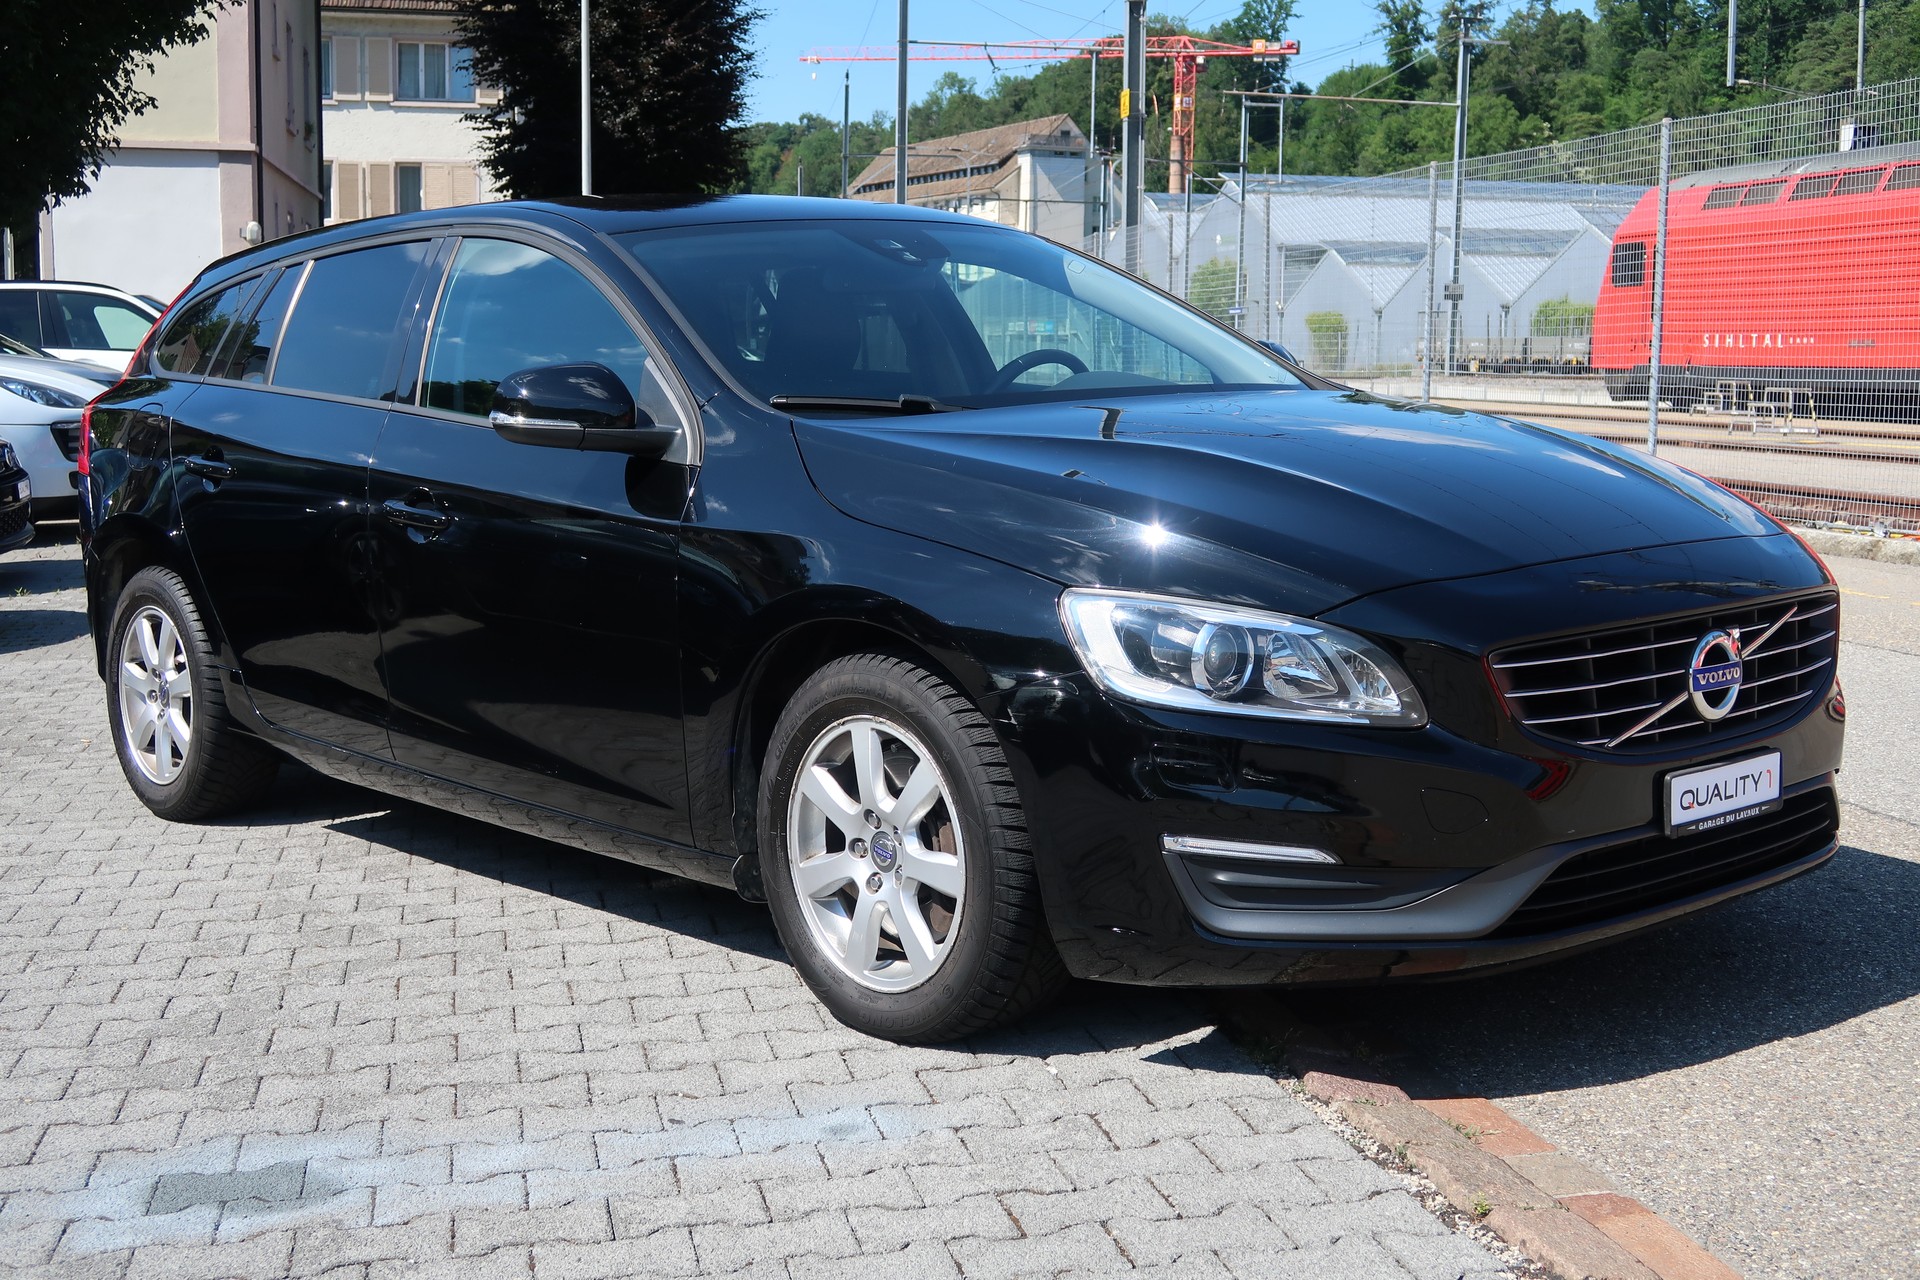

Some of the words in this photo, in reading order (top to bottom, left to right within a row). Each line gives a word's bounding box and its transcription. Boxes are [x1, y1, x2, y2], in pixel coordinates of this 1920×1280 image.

[1703, 333, 1783, 348] SIHLTAL
[1697, 667, 1740, 685] VOLVO
[1698, 816, 1725, 831] GARAGE
[1726, 813, 1737, 823] DU
[1736, 806, 1760, 819] LAVAUX
[874, 846, 891, 858] VOLVO
